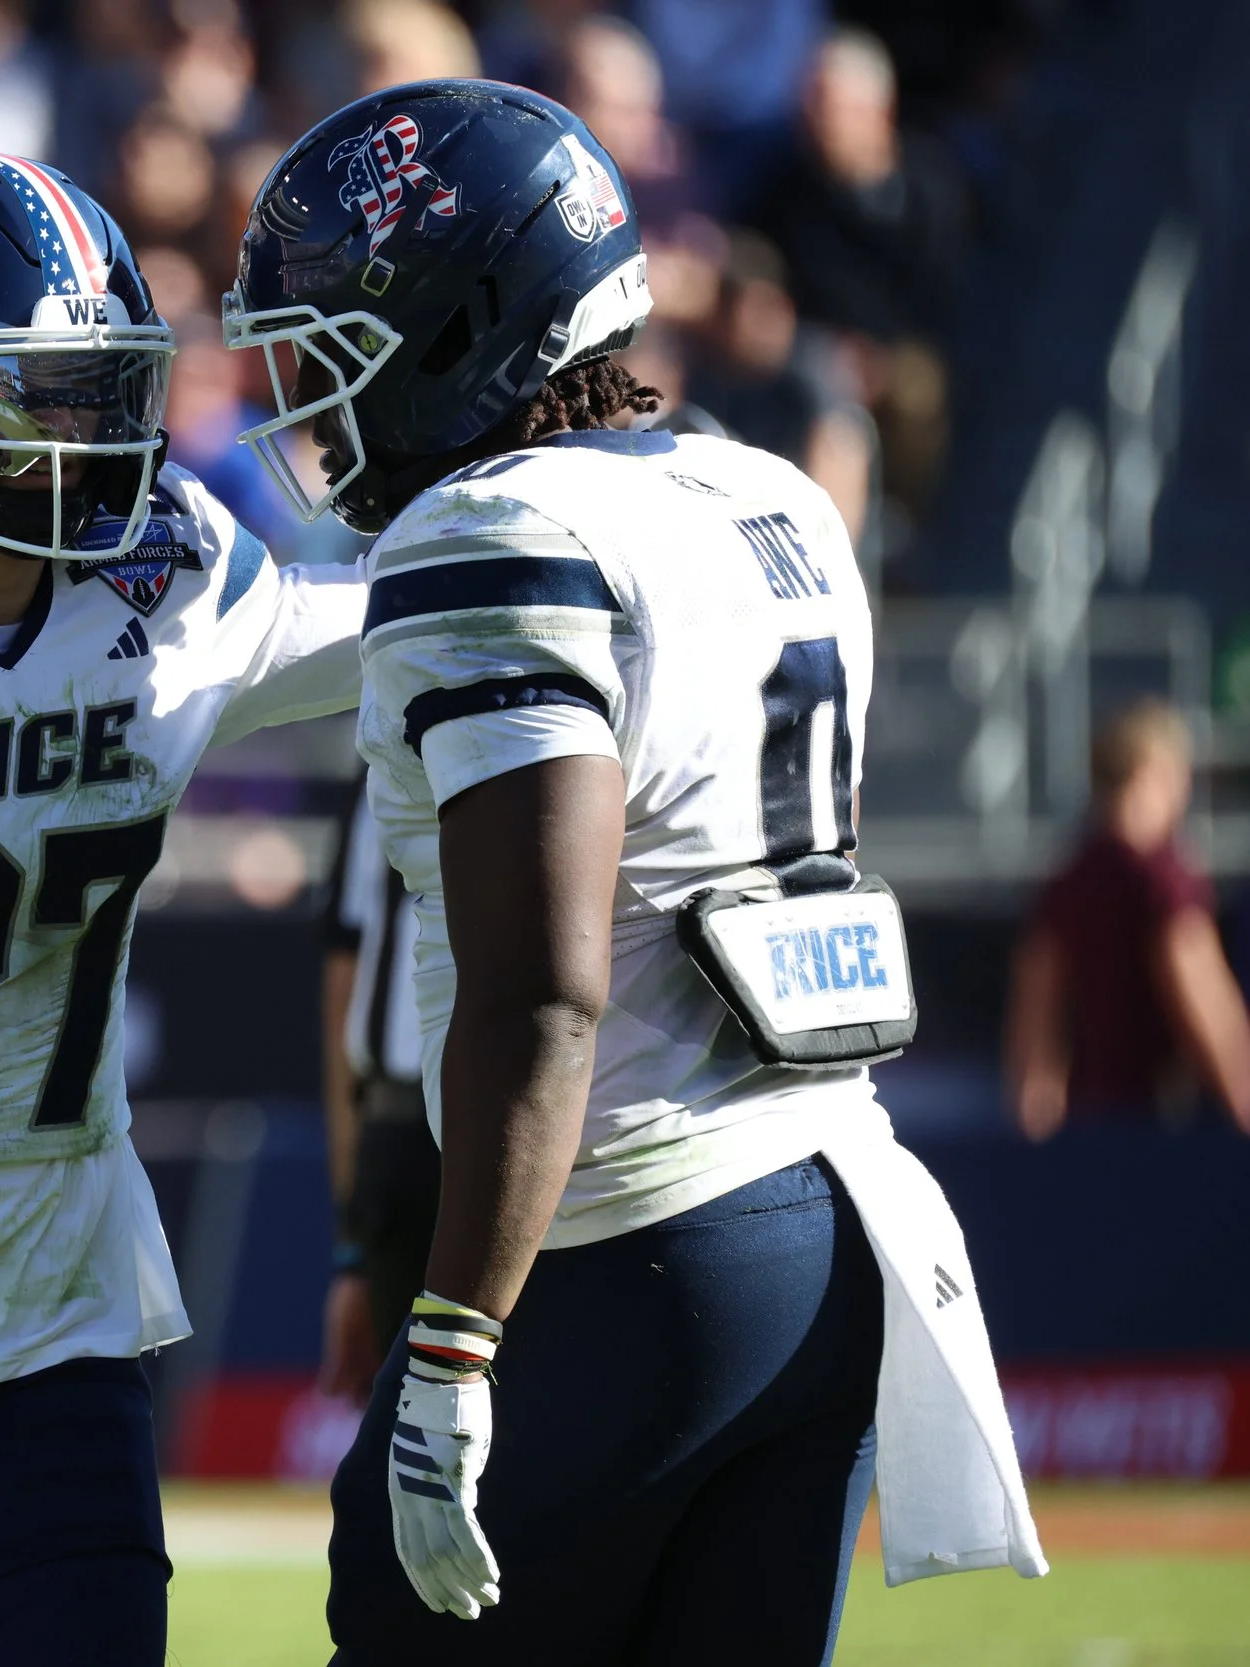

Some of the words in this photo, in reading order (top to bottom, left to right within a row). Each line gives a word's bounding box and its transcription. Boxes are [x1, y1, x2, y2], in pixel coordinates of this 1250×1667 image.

[566, 199, 587, 217] OWL
[576, 213, 588, 229] IN
[63, 298, 109, 325] WE
[129, 545, 185, 560] FORCES
[731, 511, 832, 600] AWE
[117, 564, 155, 577] BOWL
[765, 921, 889, 1001] RICE
